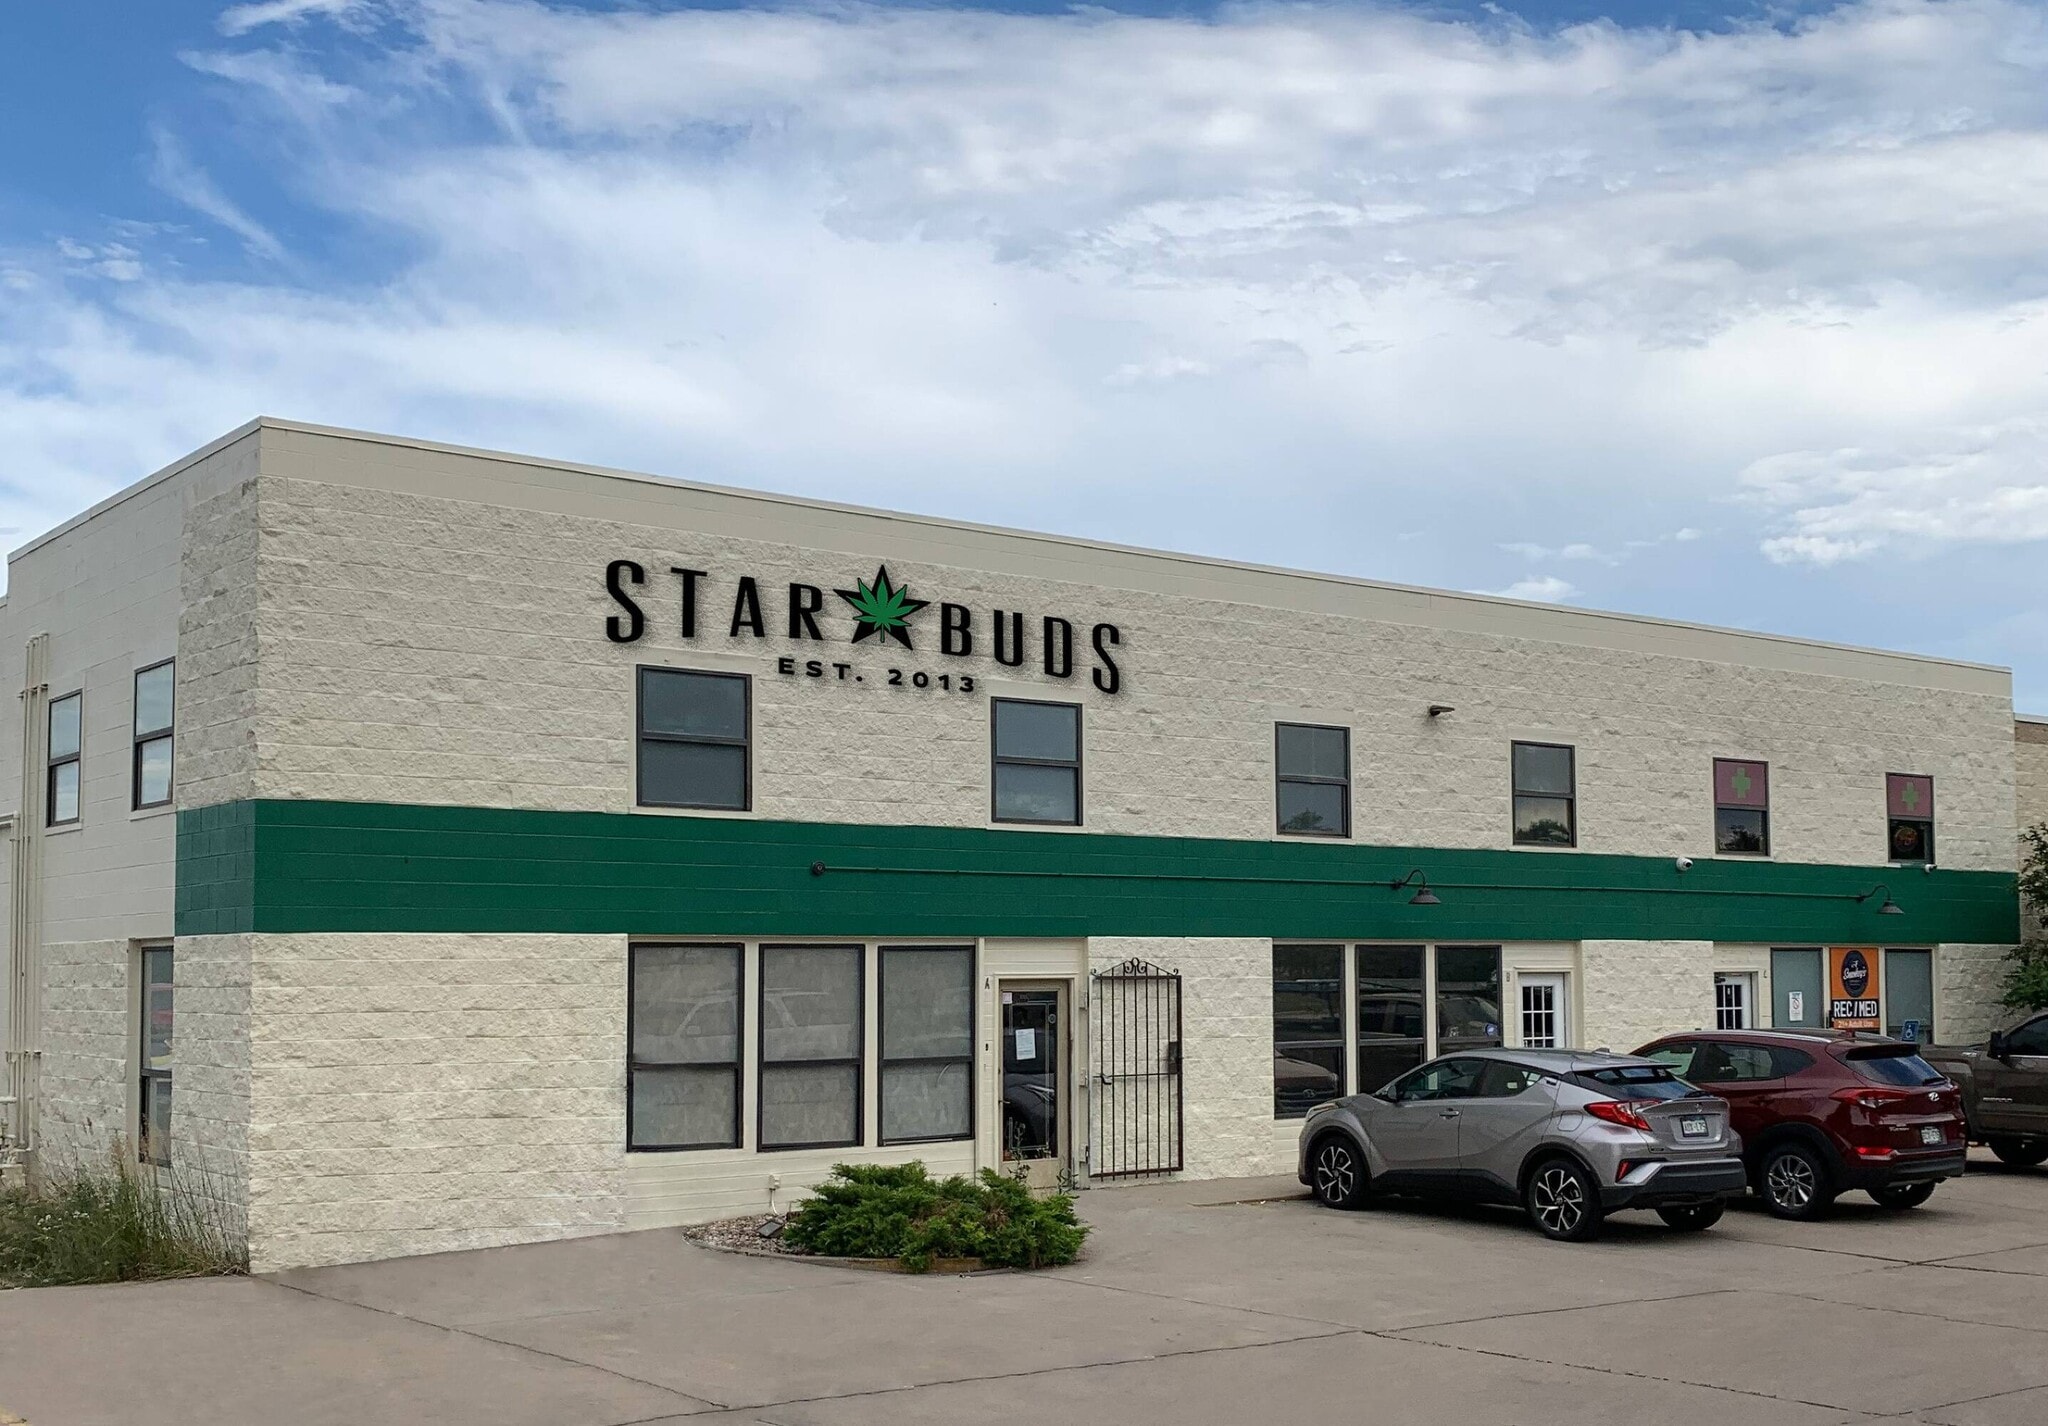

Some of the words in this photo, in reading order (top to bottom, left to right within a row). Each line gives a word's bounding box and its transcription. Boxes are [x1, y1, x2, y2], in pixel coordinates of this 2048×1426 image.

[605, 559, 824, 644] STAR
[940, 602, 1121, 695] BUDS
[778, 657, 865, 683] EST.
[888, 668, 975, 693] 2013
[1834, 1001, 1877, 1017] REC/MED
